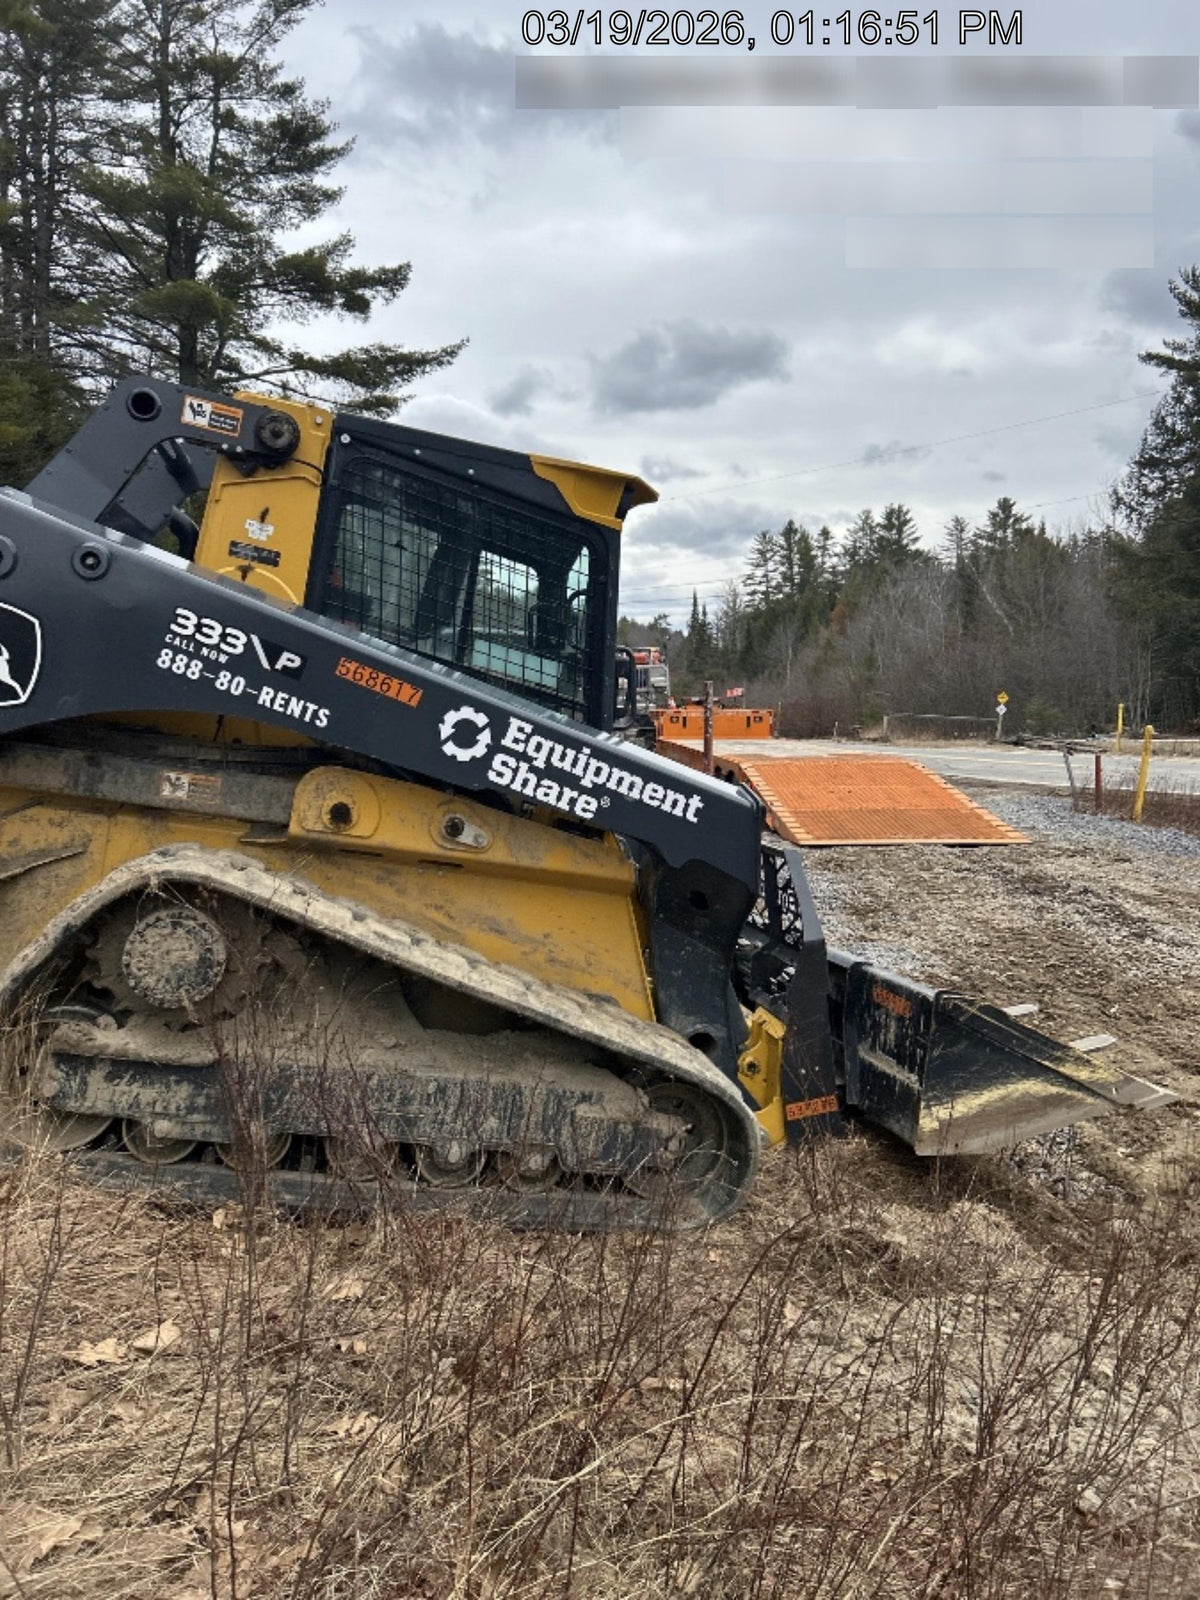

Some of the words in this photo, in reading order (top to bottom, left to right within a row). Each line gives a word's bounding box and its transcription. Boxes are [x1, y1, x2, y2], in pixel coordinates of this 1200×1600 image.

[165, 634, 195, 652] CALL
[200, 647, 230, 664] NOW
[156, 648, 331, 728] 888-80-RENTS
[339, 659, 419, 703] 568617
[500, 716, 704, 824] Equipment
